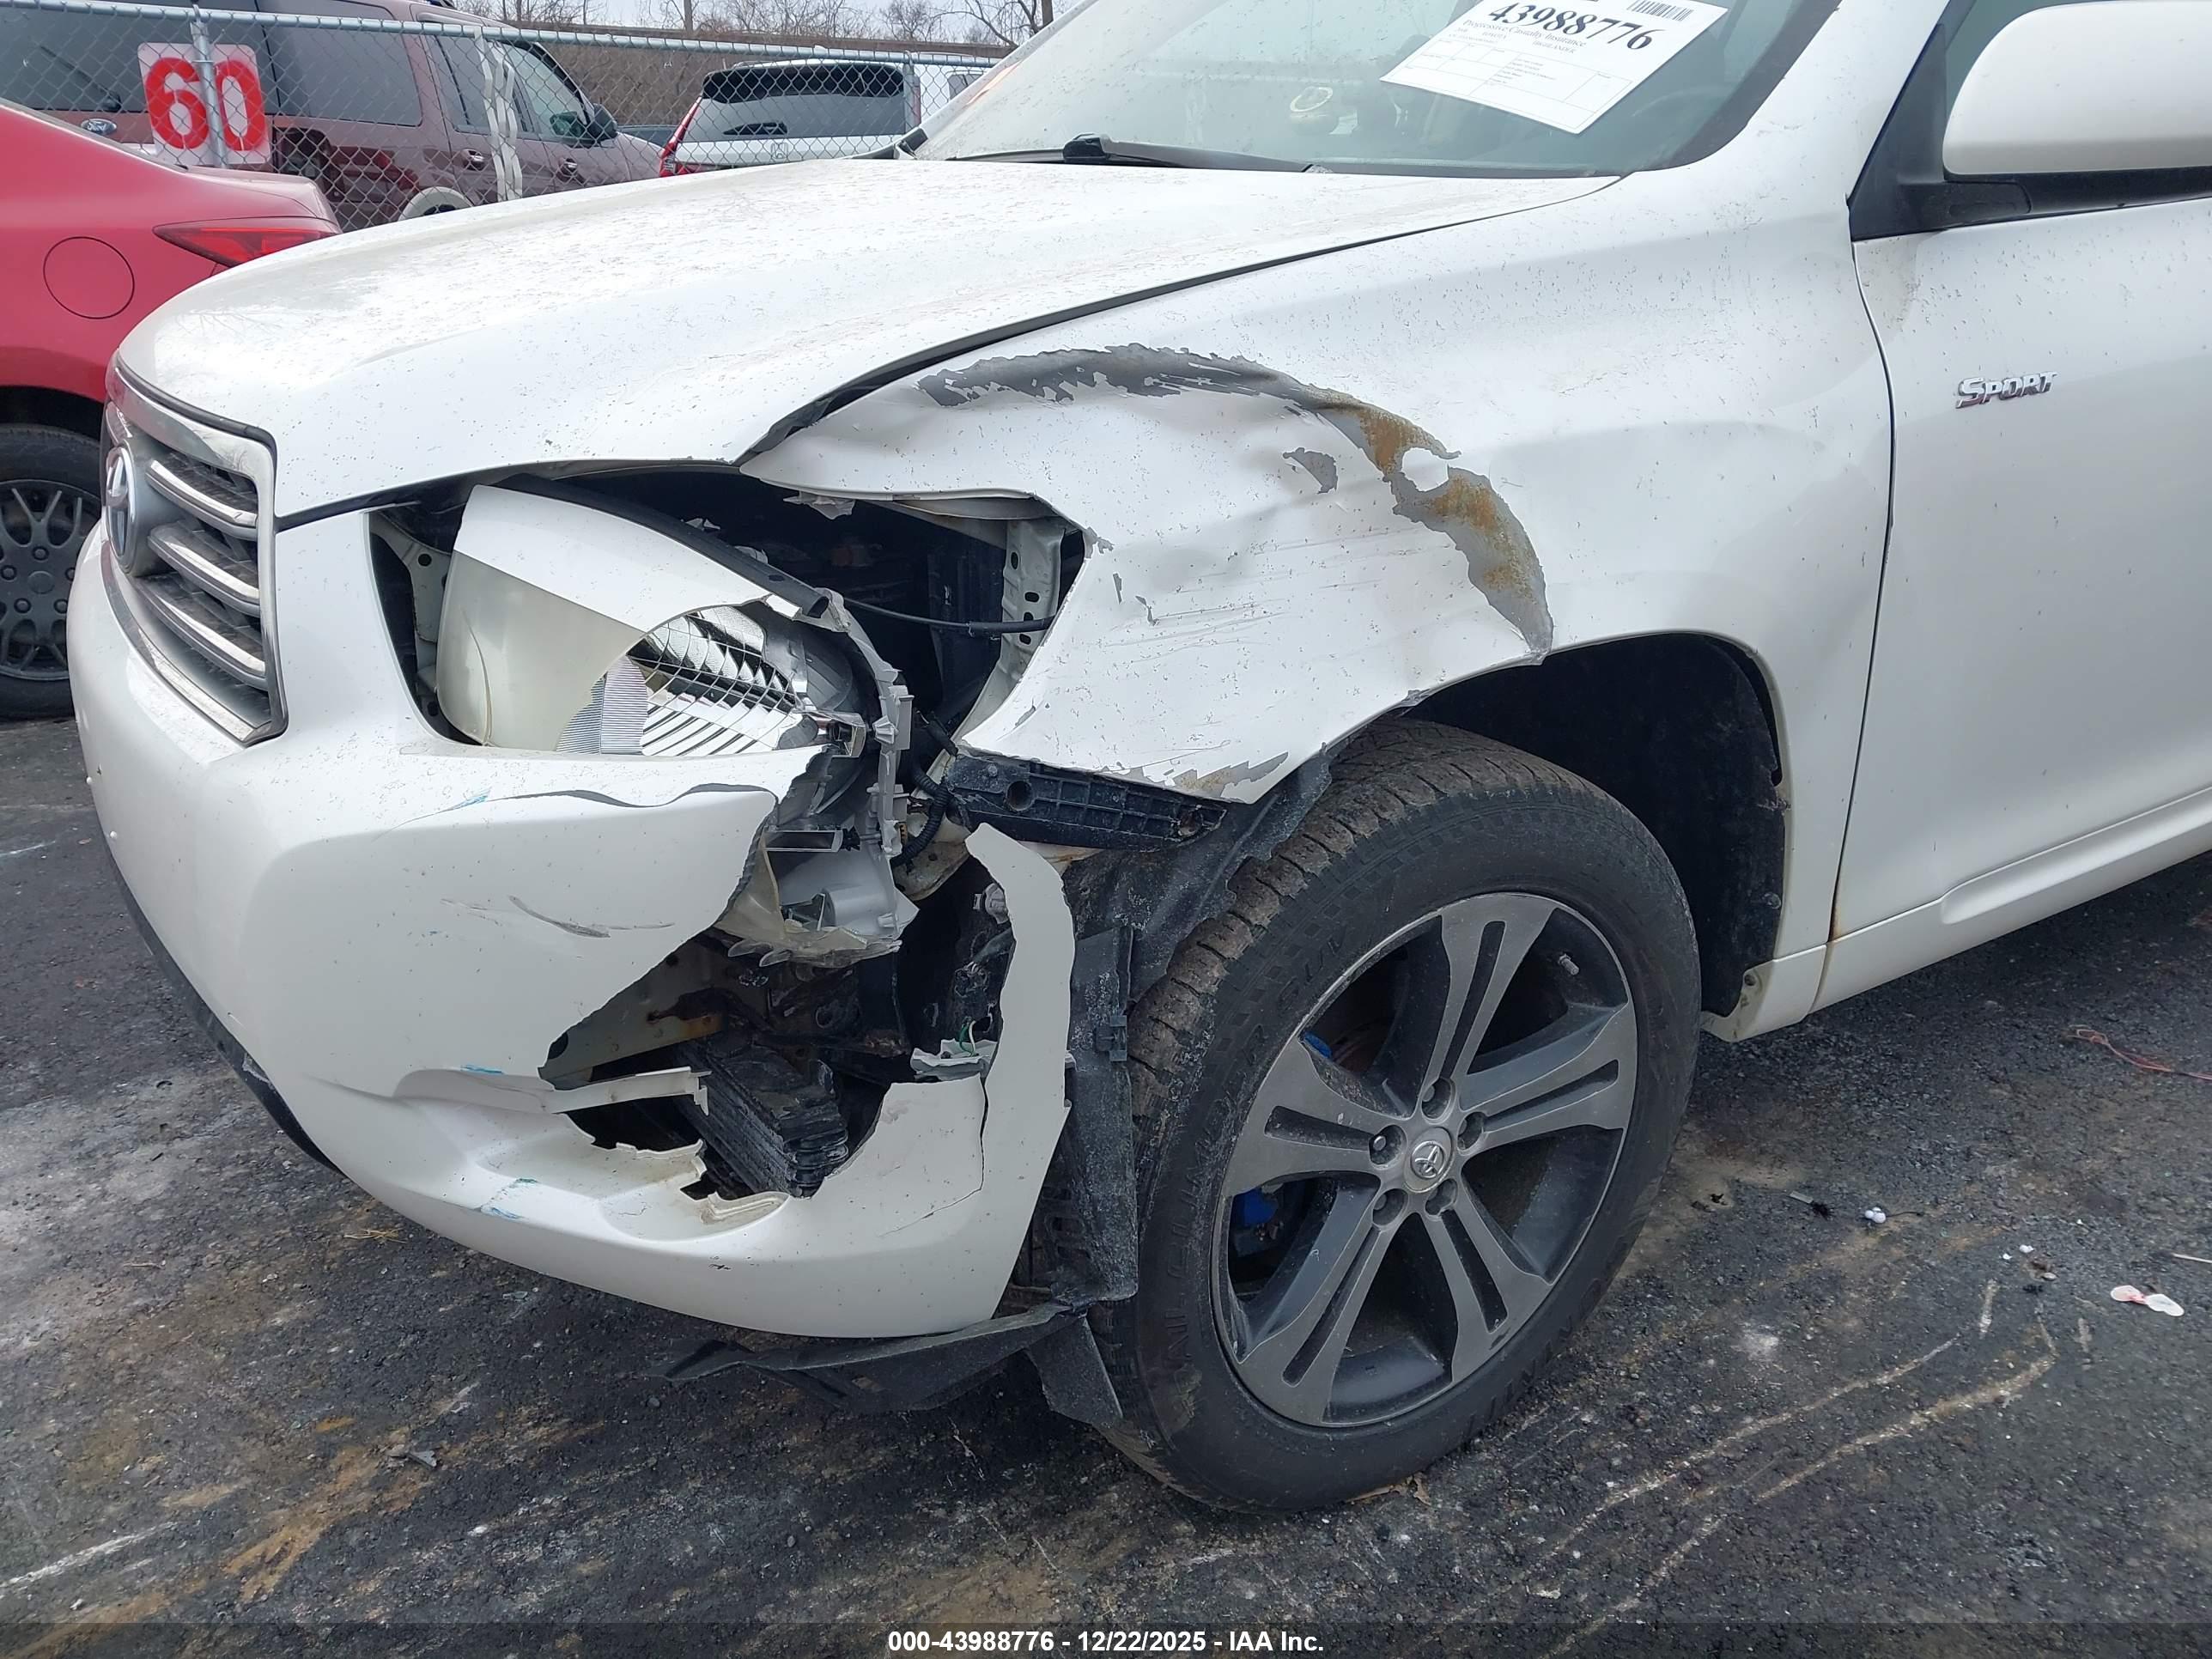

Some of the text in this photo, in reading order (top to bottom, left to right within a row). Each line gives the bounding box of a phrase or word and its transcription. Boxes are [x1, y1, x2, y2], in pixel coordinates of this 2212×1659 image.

[1488, 3, 1666, 49] 43988776
[1545, 33, 1587, 47] Insurance
[146, 57, 266, 151] 60
